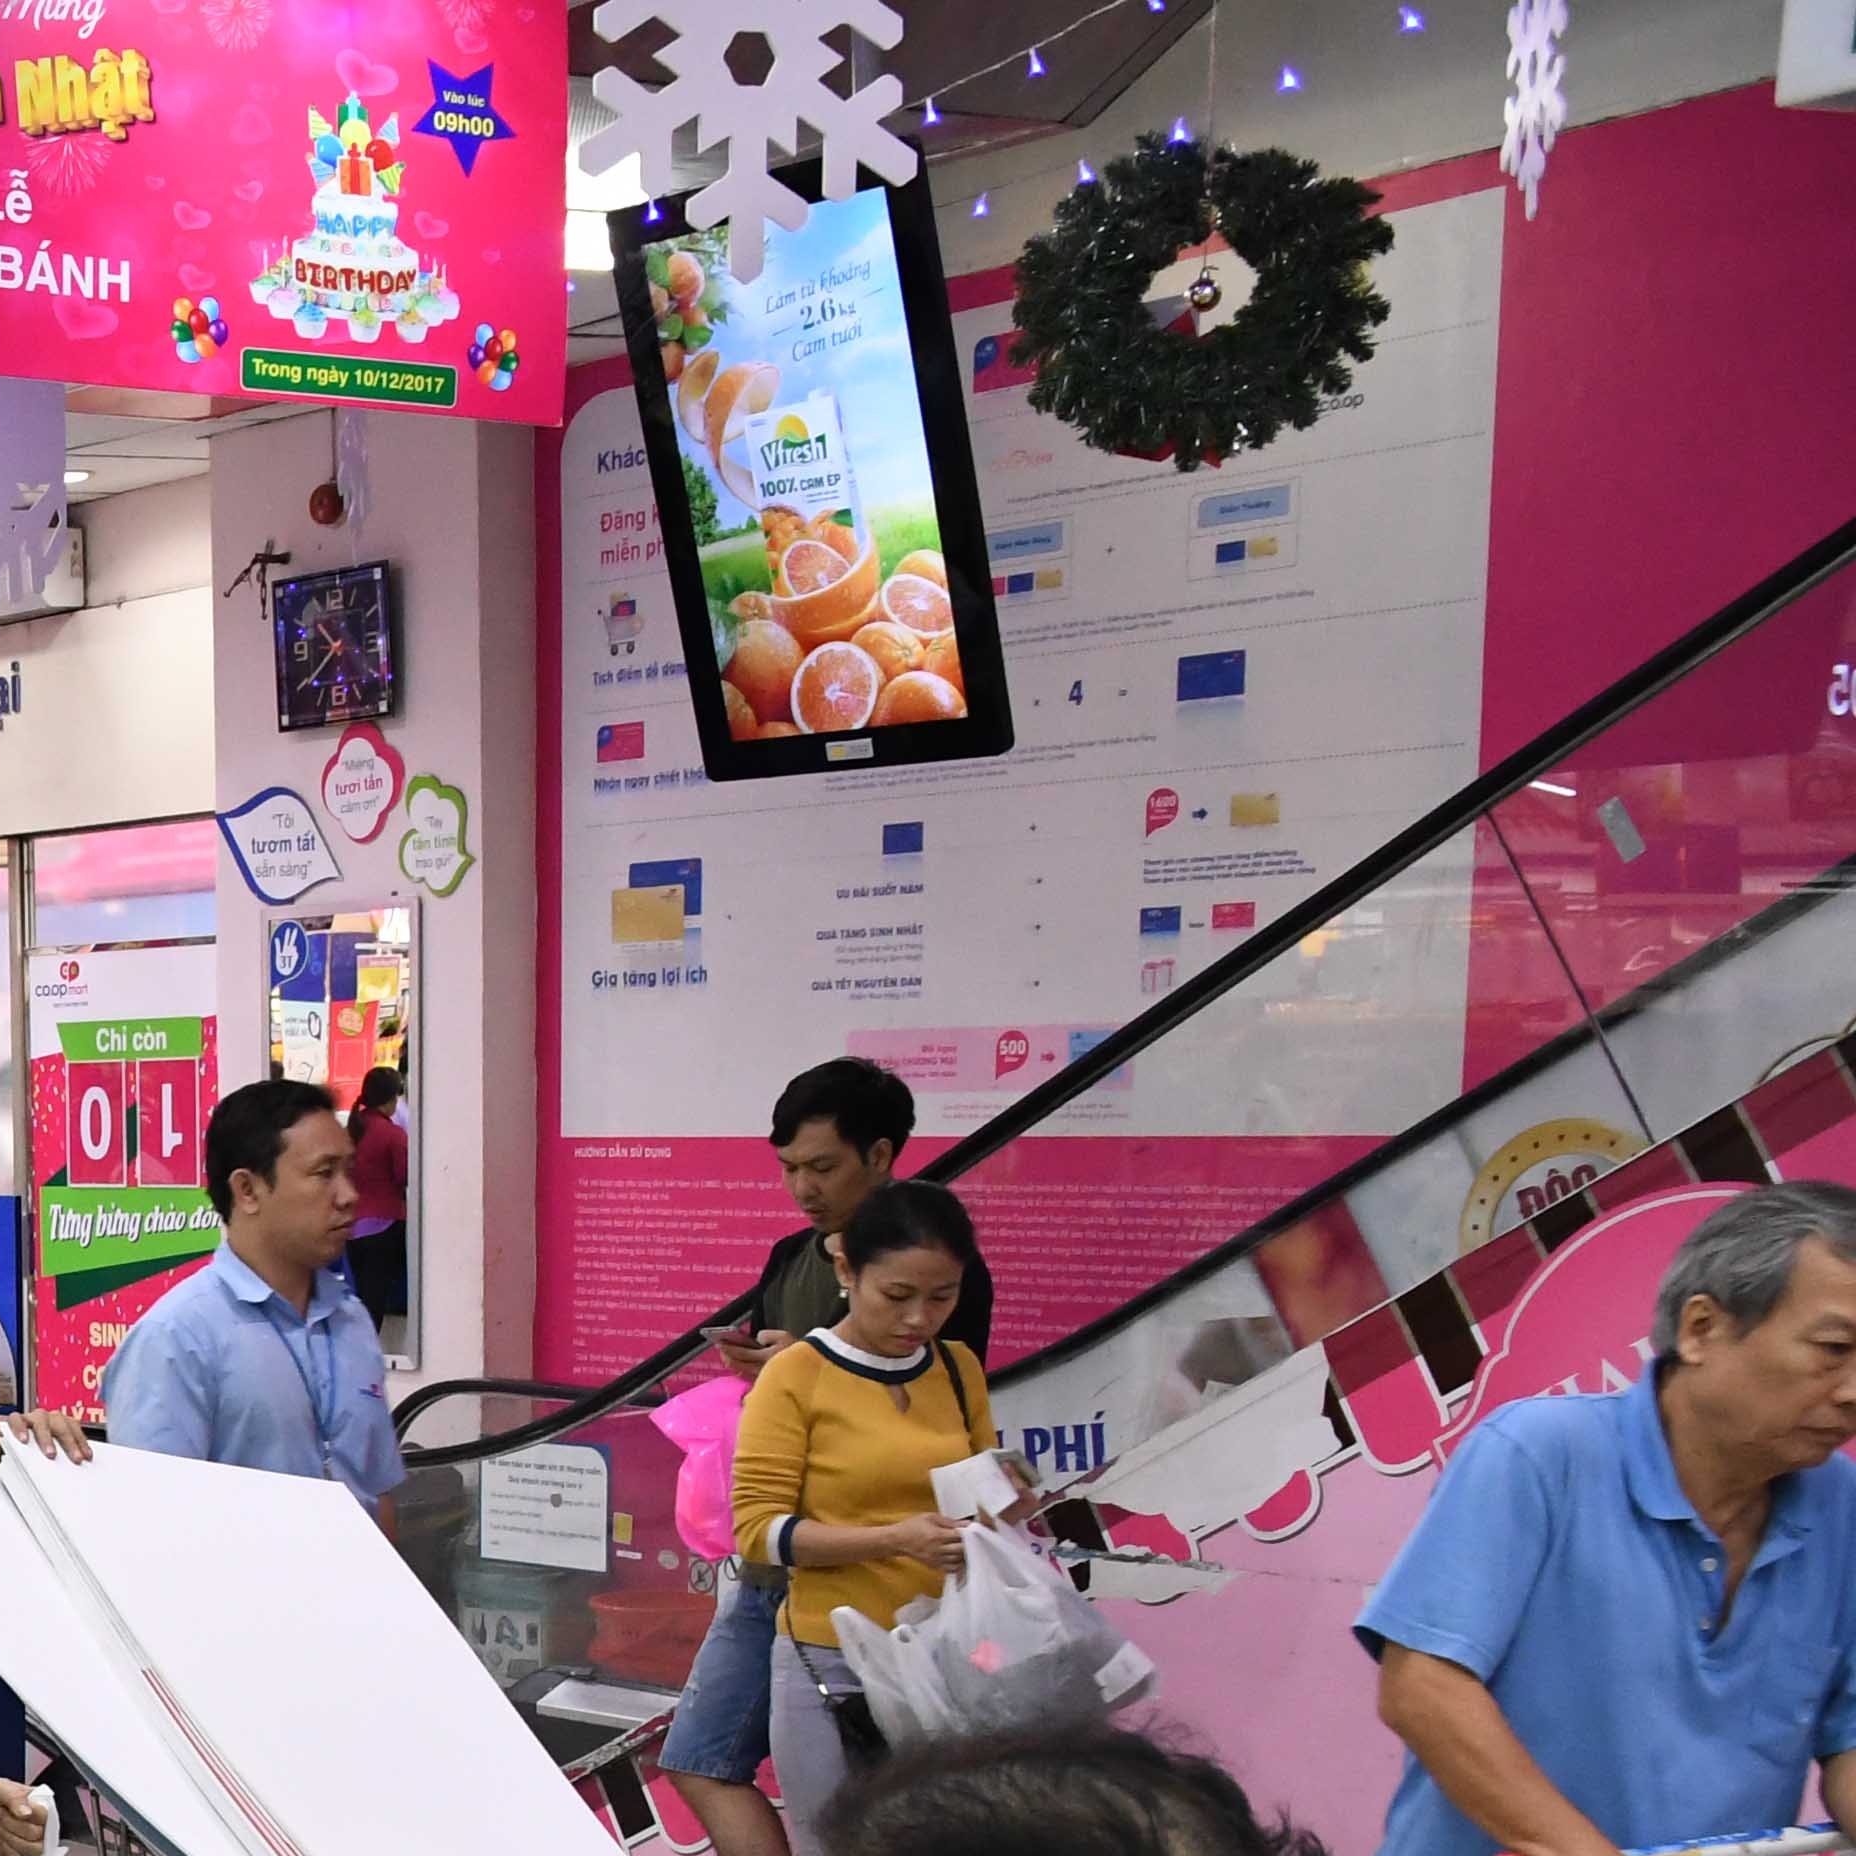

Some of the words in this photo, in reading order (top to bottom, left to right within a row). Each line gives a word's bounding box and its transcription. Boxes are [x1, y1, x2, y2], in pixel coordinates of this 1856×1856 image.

[15, 48, 156, 142] Nhật
[442, 89, 466, 105] Vào
[466, 92, 486, 108] lúc
[432, 110, 495, 138] 09h00
[294, 257, 417, 296] BIRTHDAY
[799, 297, 837, 331] 2.6
[251, 357, 303, 382] Trong
[306, 363, 350, 389] ngày
[354, 367, 445, 394] 10/12/2017
[760, 434, 828, 472] Vfresh
[760, 477, 799, 498] 100%
[800, 476, 825, 491] CAM
[600, 508, 647, 533] Đăng
[600, 538, 641, 566] miễn
[1067, 679, 1084, 706] 4
[334, 776, 361, 797] tươi
[295, 829, 316, 852] tất
[591, 968, 618, 990] Gia
[622, 967, 657, 990] tăng
[661, 966, 681, 988] lợi
[685, 964, 708, 985] ích
[132, 1024, 168, 1052] còn
[998, 1036, 1027, 1055] 500
[79, 1085, 113, 1161] 0
[95, 1201, 142, 1243] bừng
[143, 1206, 187, 1235] chào
[1022, 1411, 1108, 1476] PHÍ
